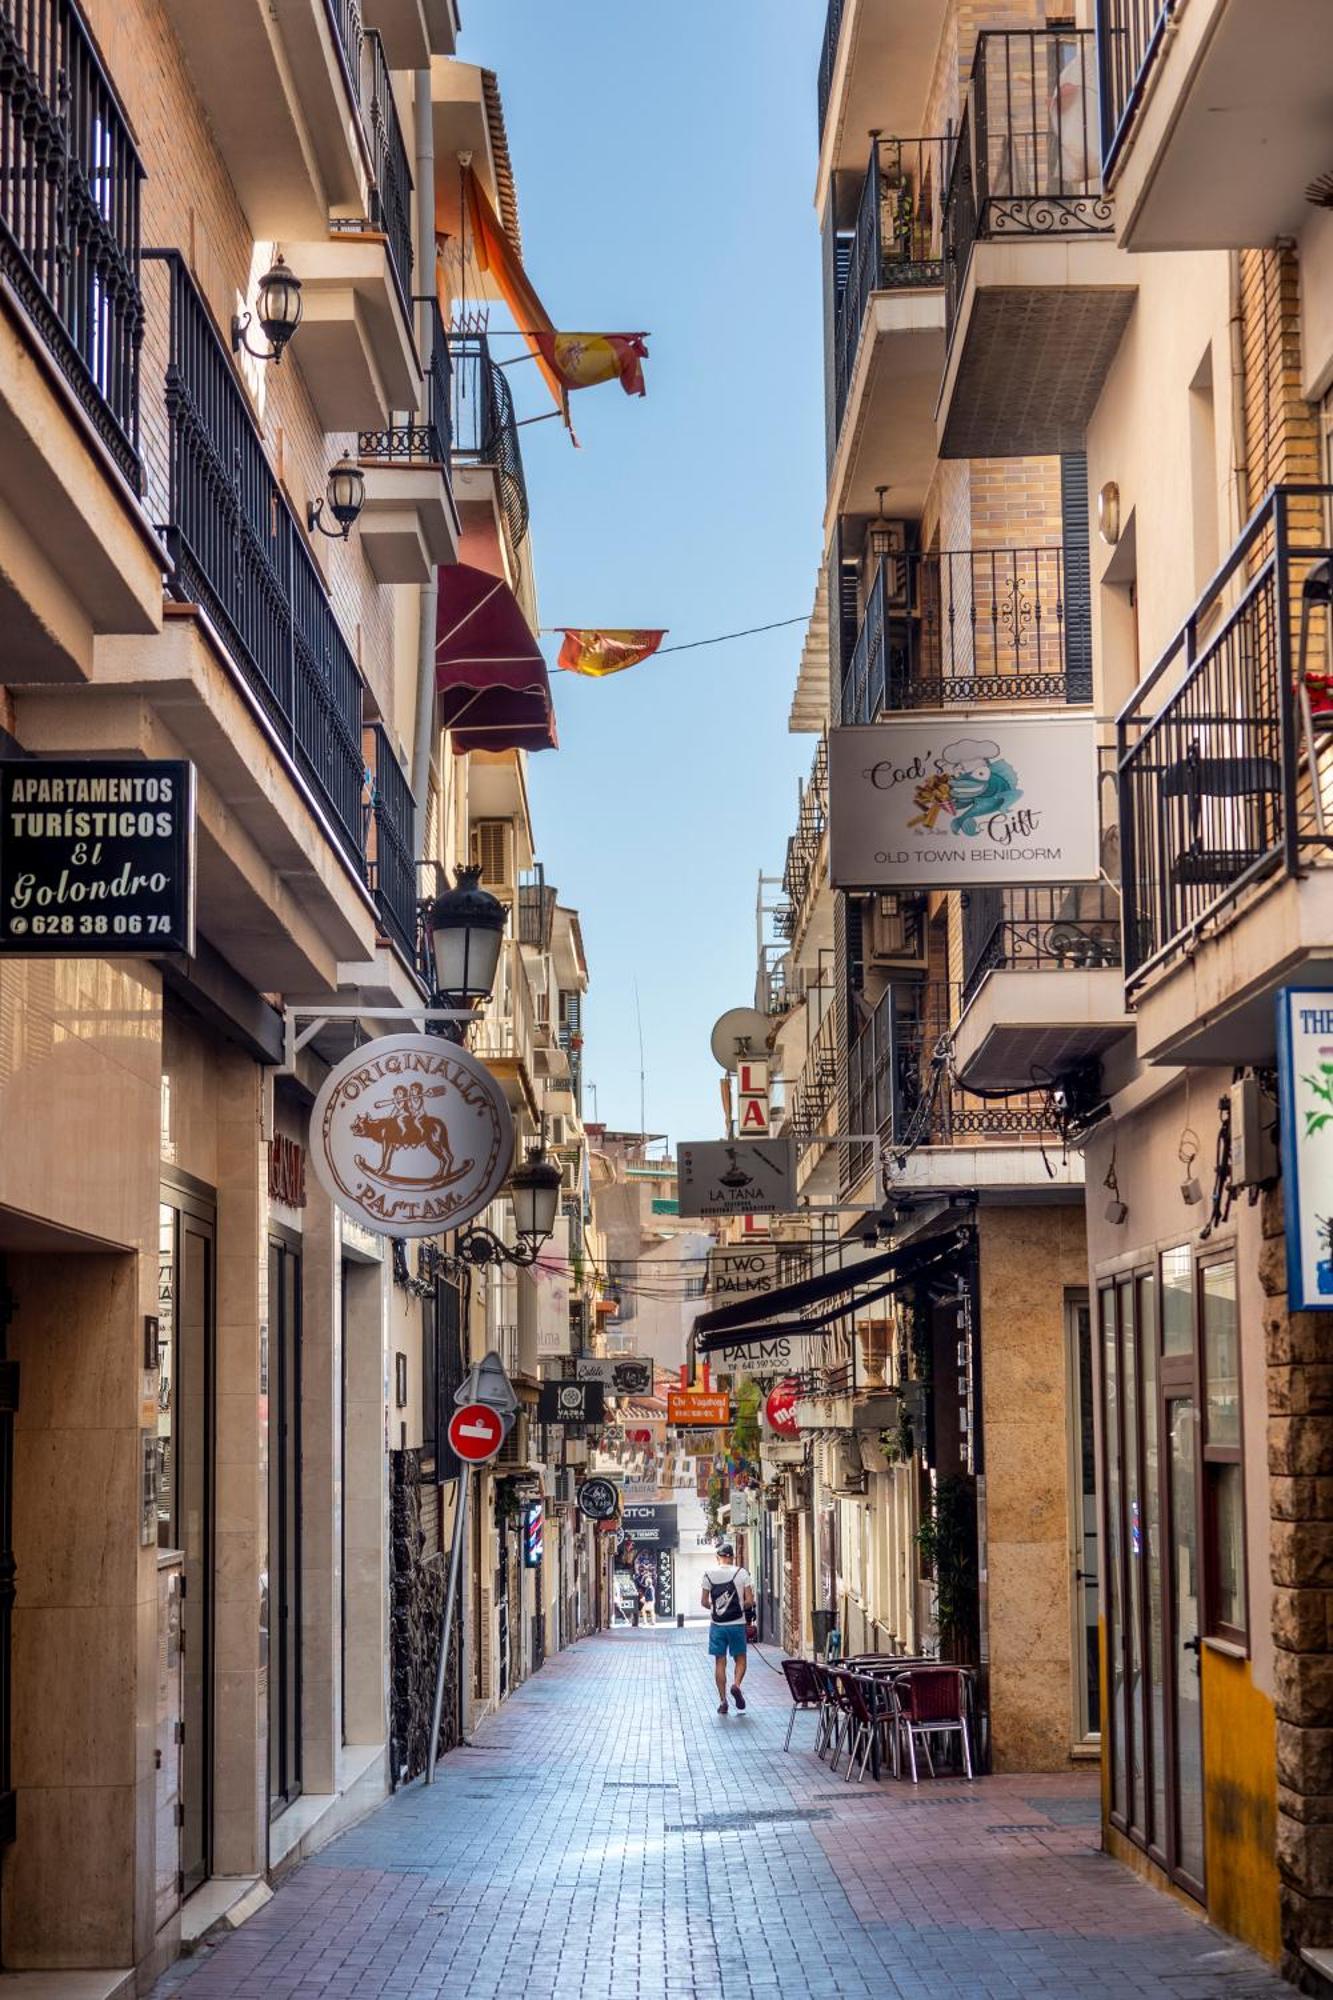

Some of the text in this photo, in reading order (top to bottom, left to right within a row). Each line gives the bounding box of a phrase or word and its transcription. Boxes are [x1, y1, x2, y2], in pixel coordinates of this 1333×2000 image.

[863, 750, 946, 790] Cod's
[11, 778, 173, 803] APARTAMENTOS
[11, 808, 173, 837] TURÍSTICOS
[976, 808, 1043, 845] Gift
[71, 842, 102, 865] El
[874, 848, 1062, 864] OLD TOWN BENIDORM
[10, 862, 171, 909] Golondro
[32, 915, 171, 934] 628 38 06 74
[709, 1188, 765, 1201] LA TANA
[721, 1257, 765, 1273] TWO
[716, 1276, 772, 1292] PALMS
[723, 1338, 791, 1362] PALMS
